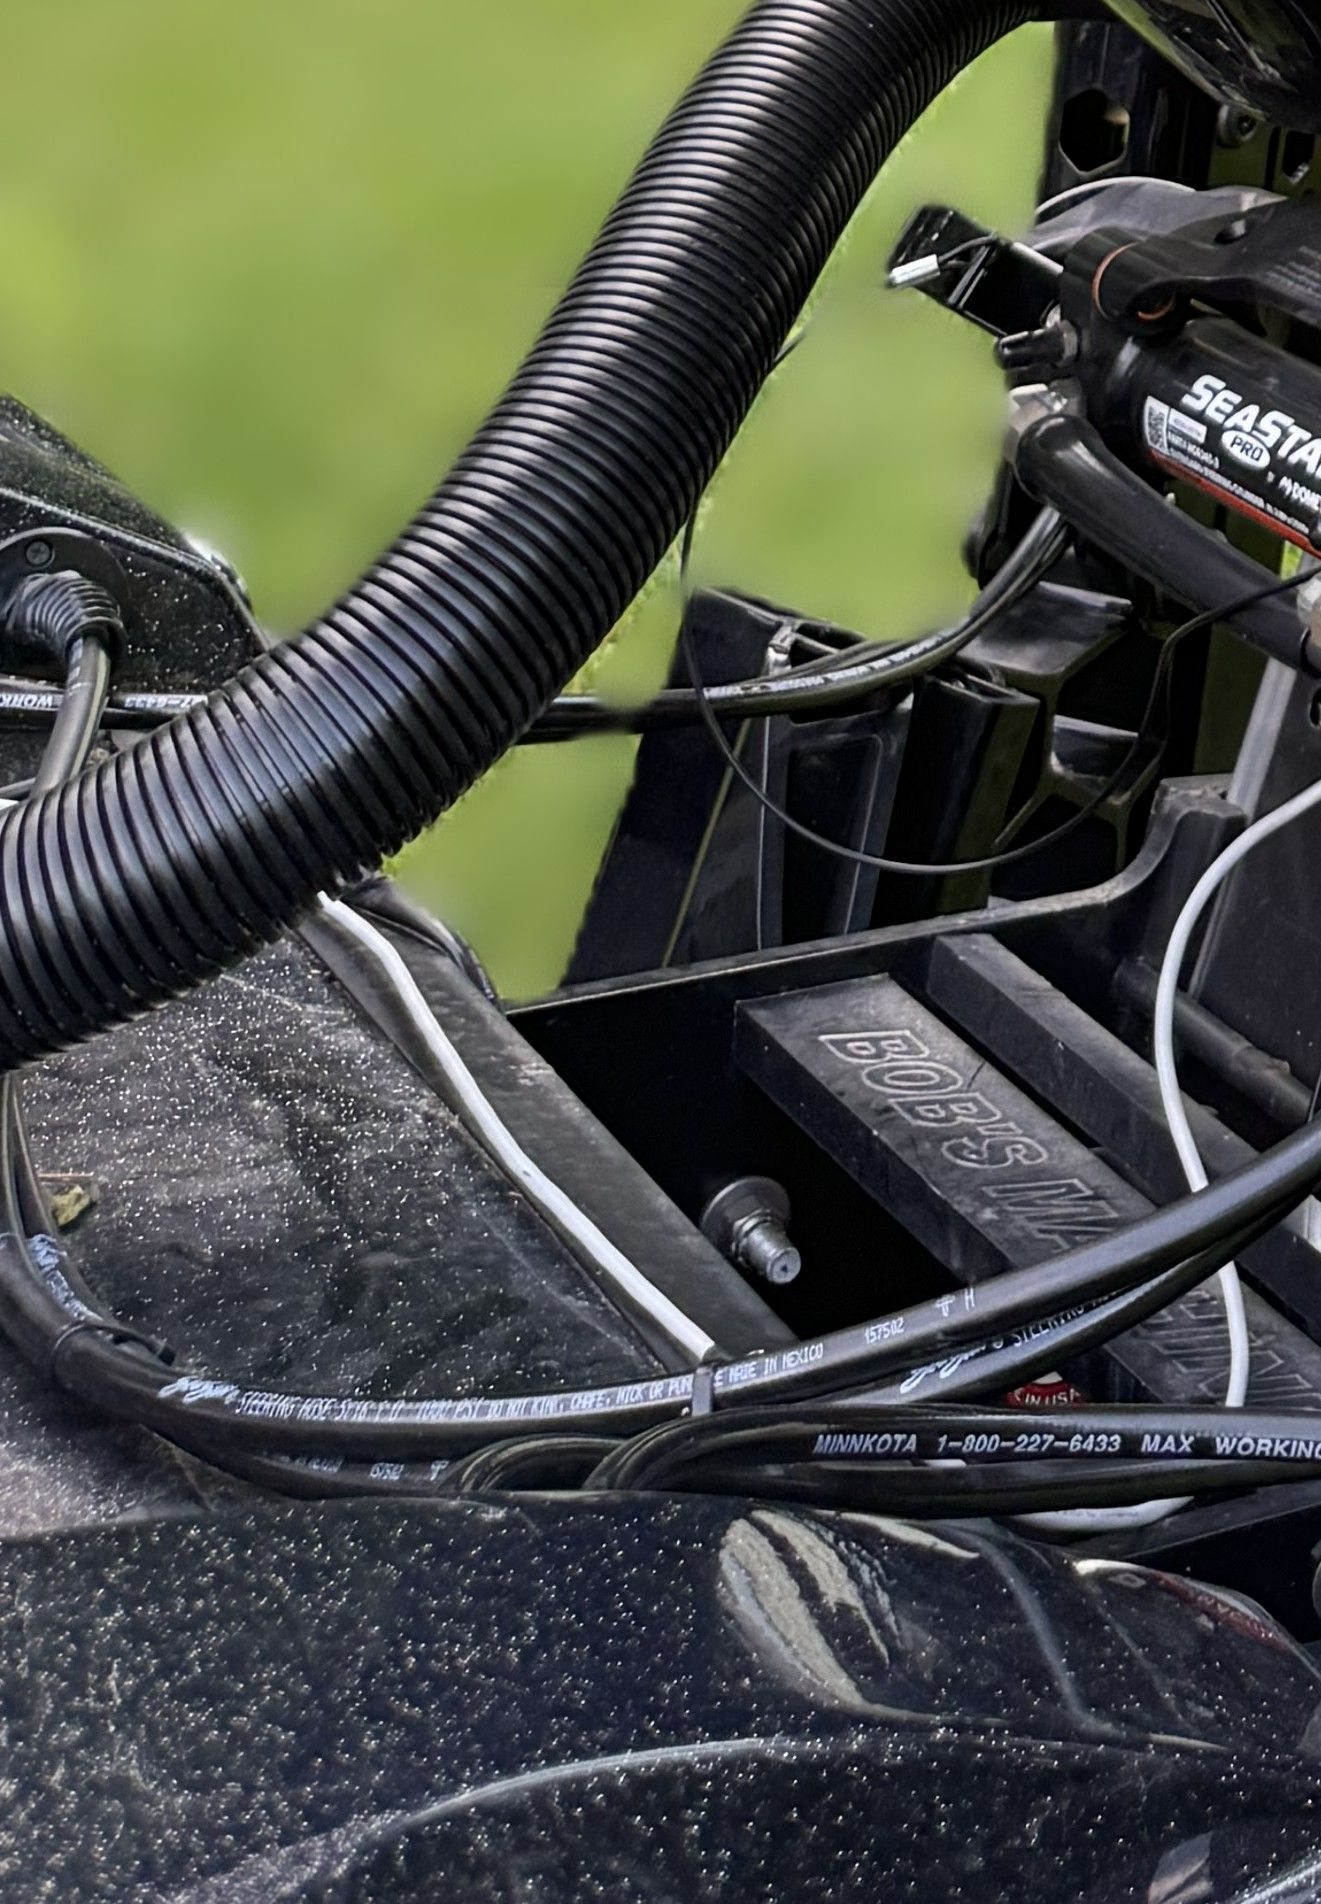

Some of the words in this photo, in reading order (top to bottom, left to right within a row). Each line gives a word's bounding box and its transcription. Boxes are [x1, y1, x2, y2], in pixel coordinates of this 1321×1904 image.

[1231, 434, 1264, 462] PRO
[817, 1029, 1049, 1170] BOB'S
[813, 1433, 918, 1455] MINNKOTA
[937, 1433, 1123, 1454] 1-800-227-6433
[1141, 1434, 1199, 1454] MAX
